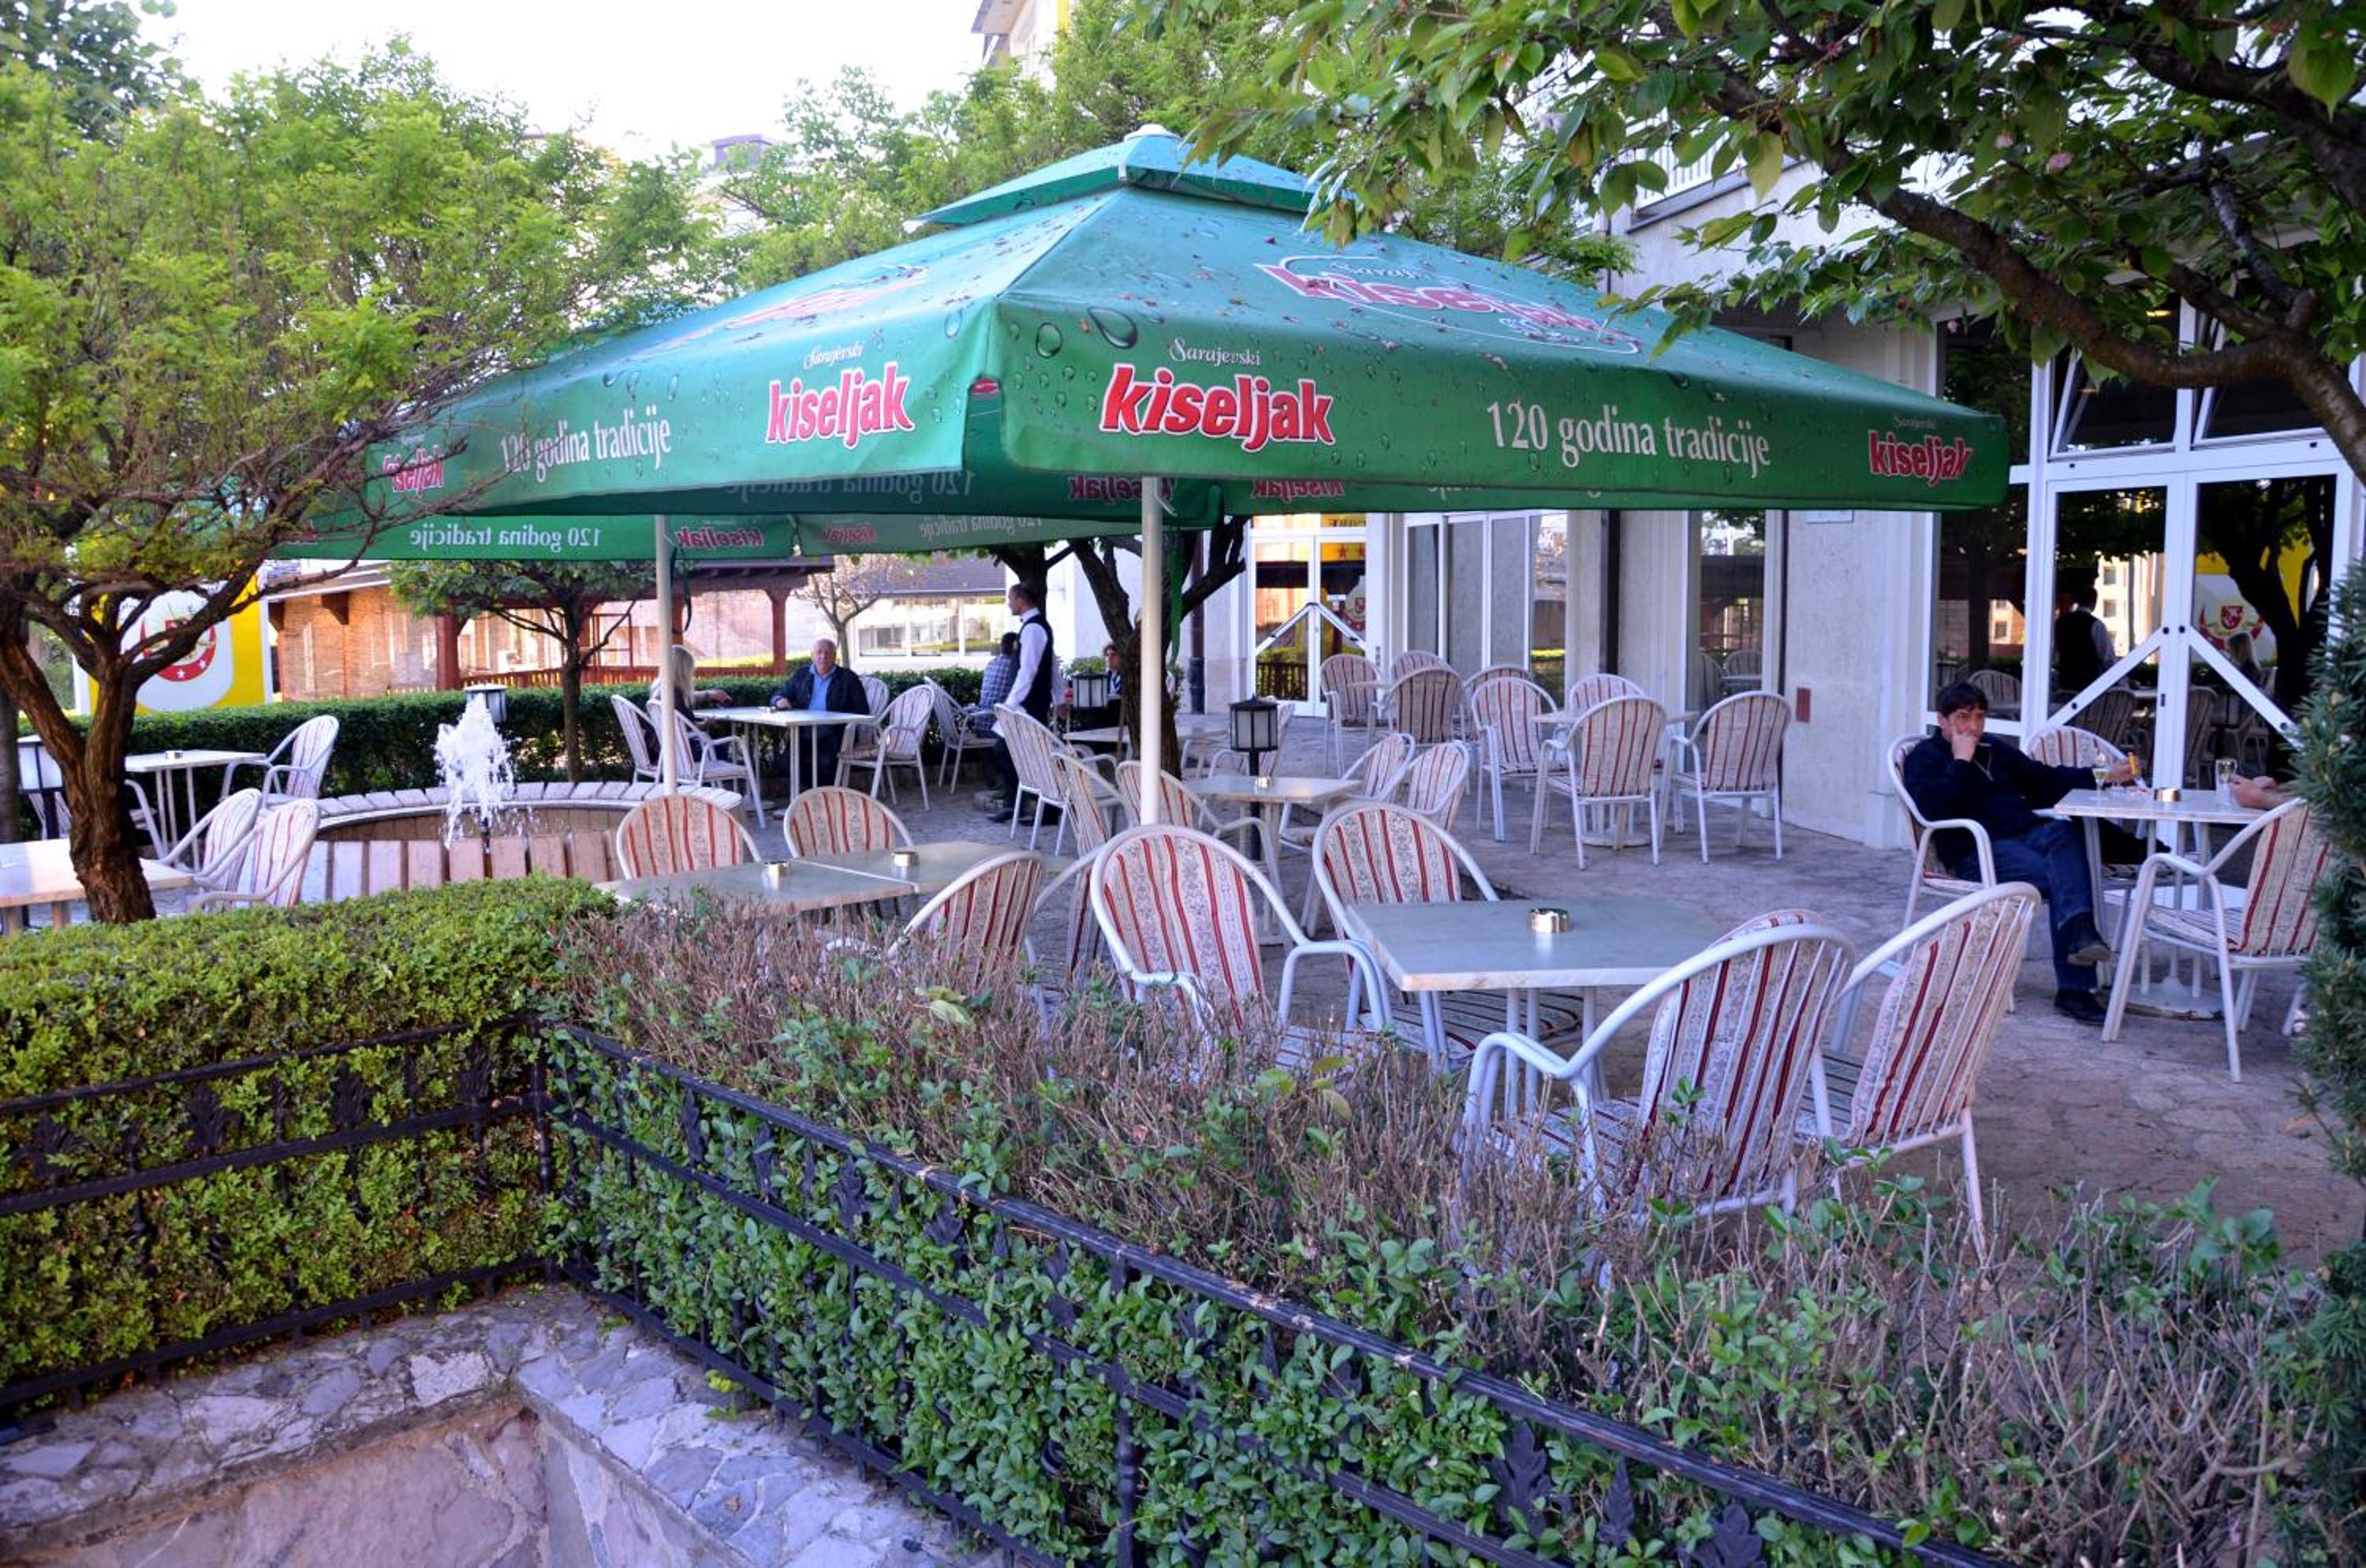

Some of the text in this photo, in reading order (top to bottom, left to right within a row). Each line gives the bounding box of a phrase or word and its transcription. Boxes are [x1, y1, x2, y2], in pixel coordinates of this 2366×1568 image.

[1168, 338, 1261, 366] Sarajevski
[766, 360, 915, 449] kiseljak
[1099, 363, 1336, 451] kiseljak
[1487, 400, 1770, 477] 120 godina tradicije
[534, 420, 591, 483] godina
[593, 405, 672, 469] tradicije
[1868, 429, 1973, 487] kiseljak
